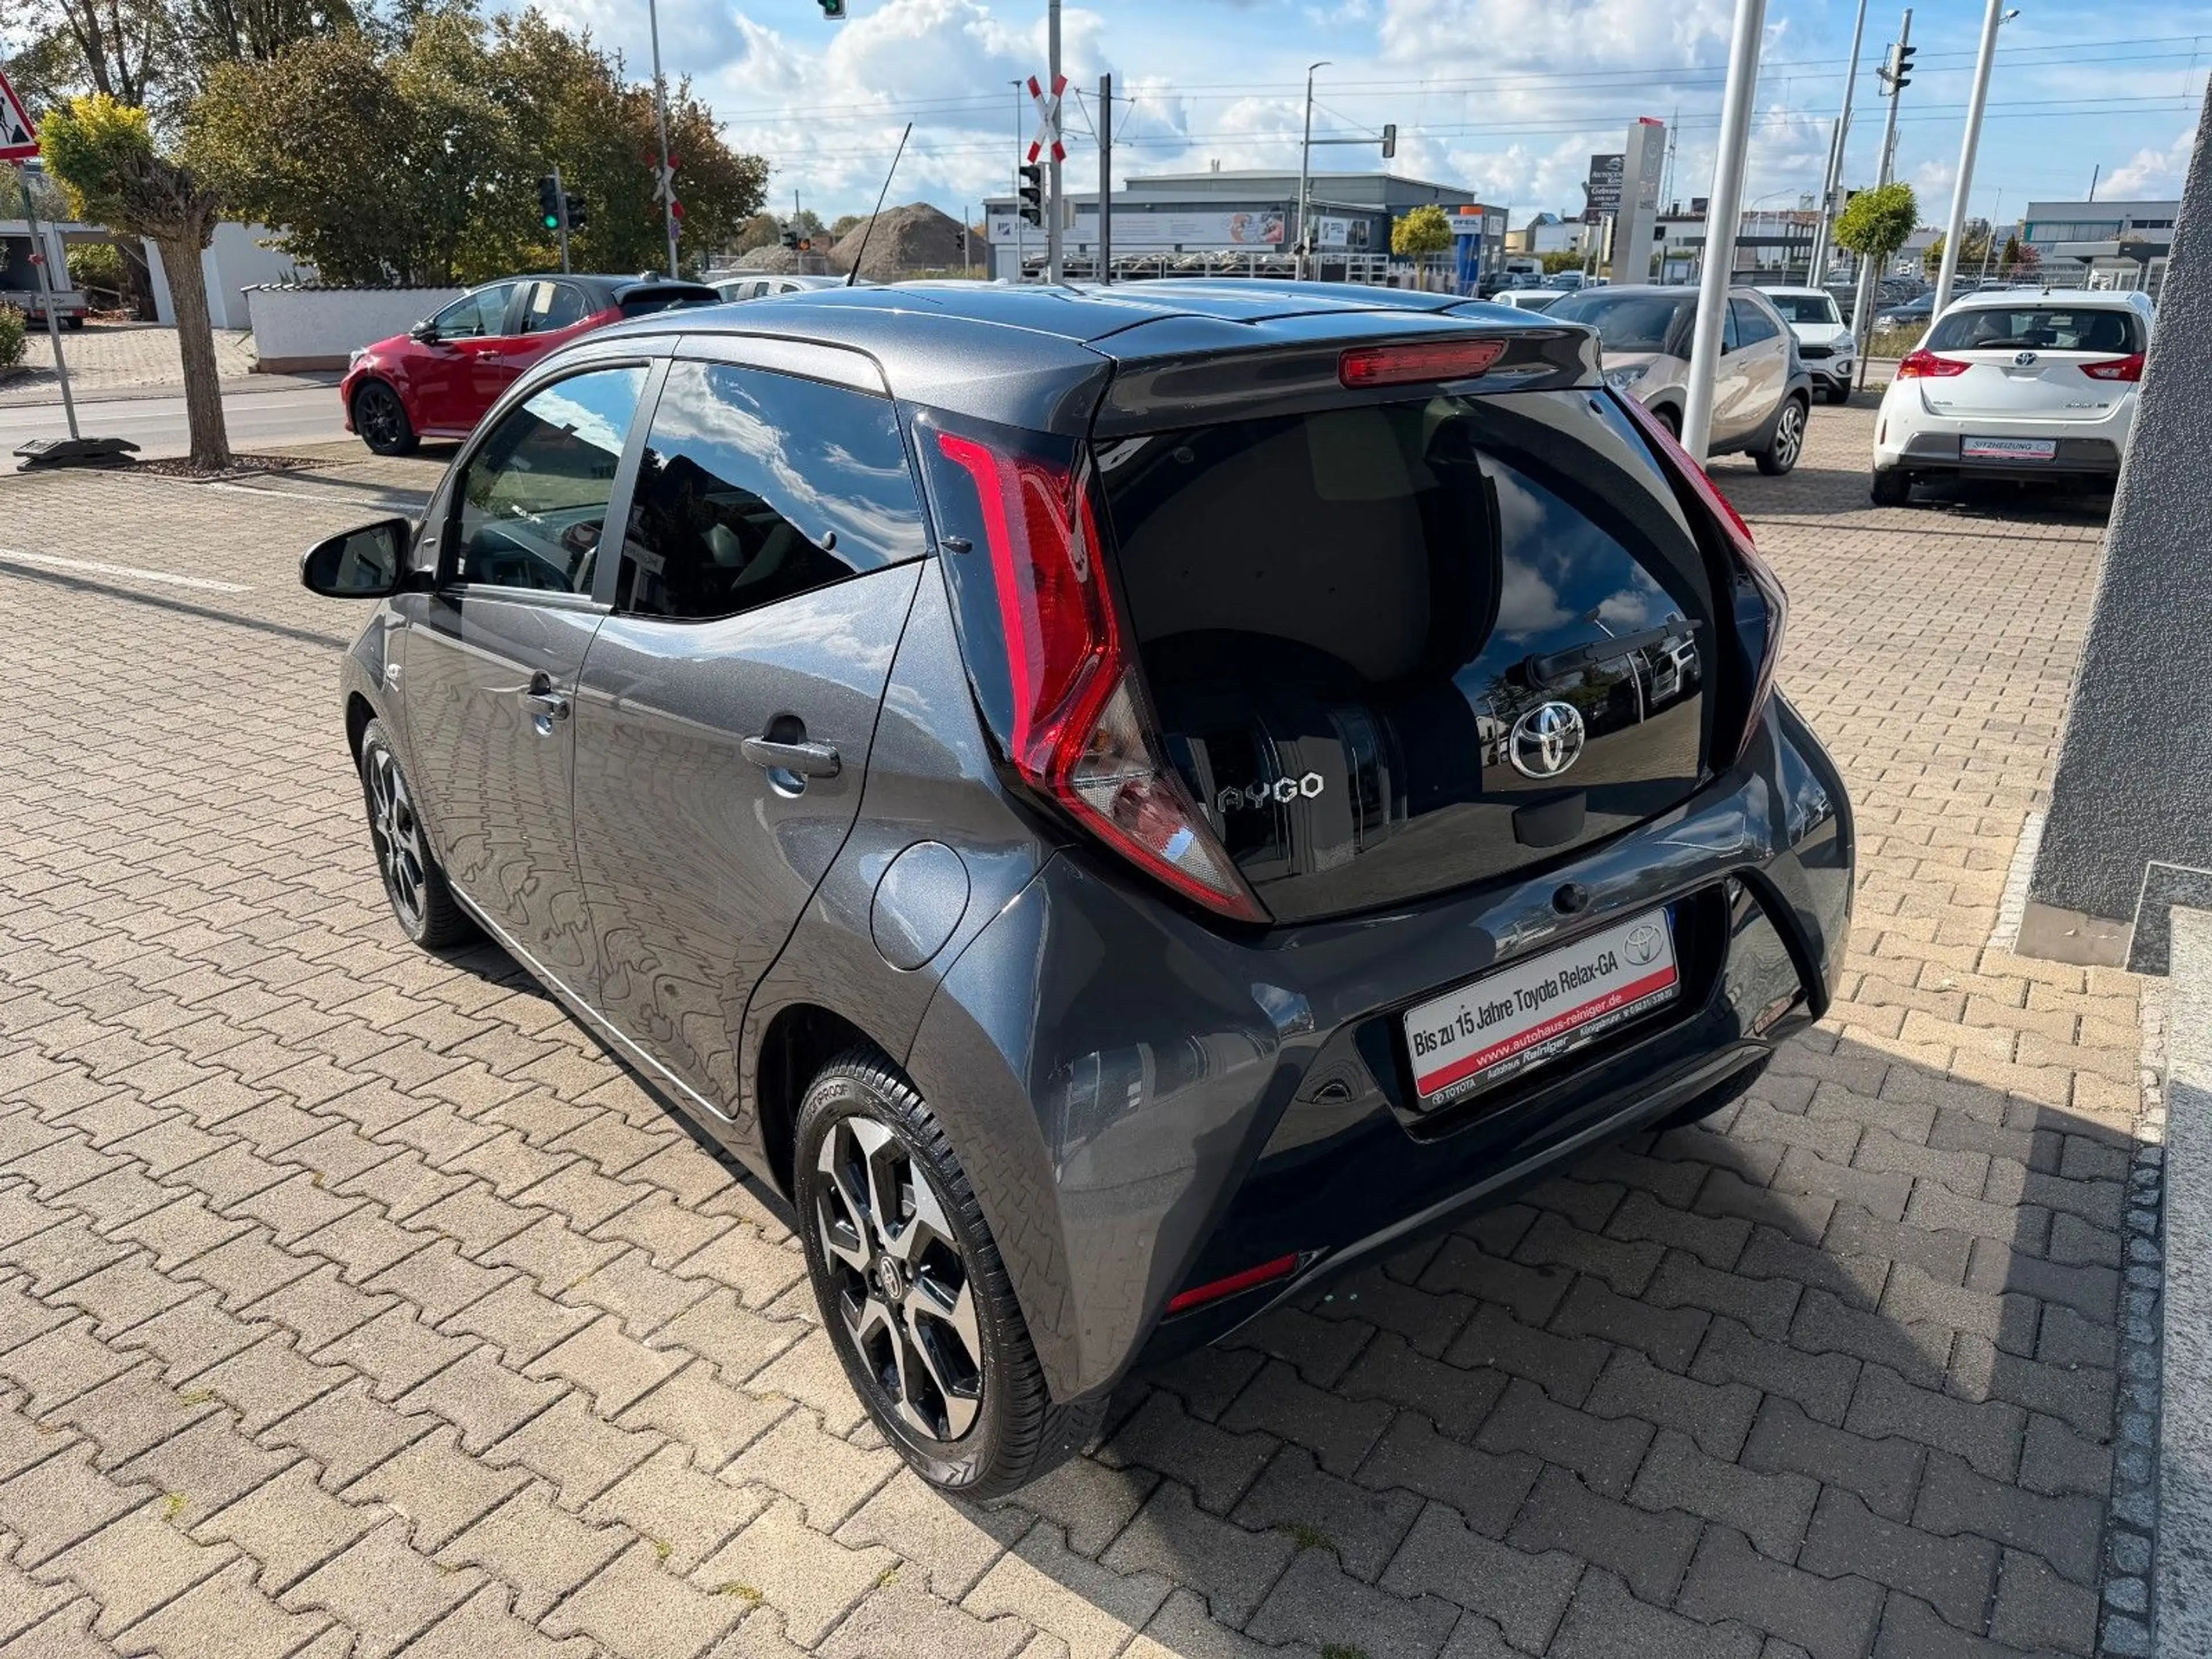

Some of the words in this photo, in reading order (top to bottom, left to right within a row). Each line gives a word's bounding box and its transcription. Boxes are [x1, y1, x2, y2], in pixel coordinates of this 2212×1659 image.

[1974, 441, 2032, 450] SITZHEIZUNG
[1218, 772, 1324, 812] AYGO
[1413, 1031, 1437, 1056] Bis
[1438, 1024, 1456, 1047] zu
[1456, 1012, 1475, 1037] 15
[1476, 1001, 1514, 1030] Jahre
[1513, 979, 1559, 1011] Toyota
[1558, 950, 1619, 994] Relax-GA
[1476, 994, 1623, 1066] www.autohaus-reiniger.de
[1444, 1080, 1476, 1099] TOYOTA
[1487, 1059, 1520, 1080] Autohaus
[1522, 1036, 1569, 1063] Reiniger
